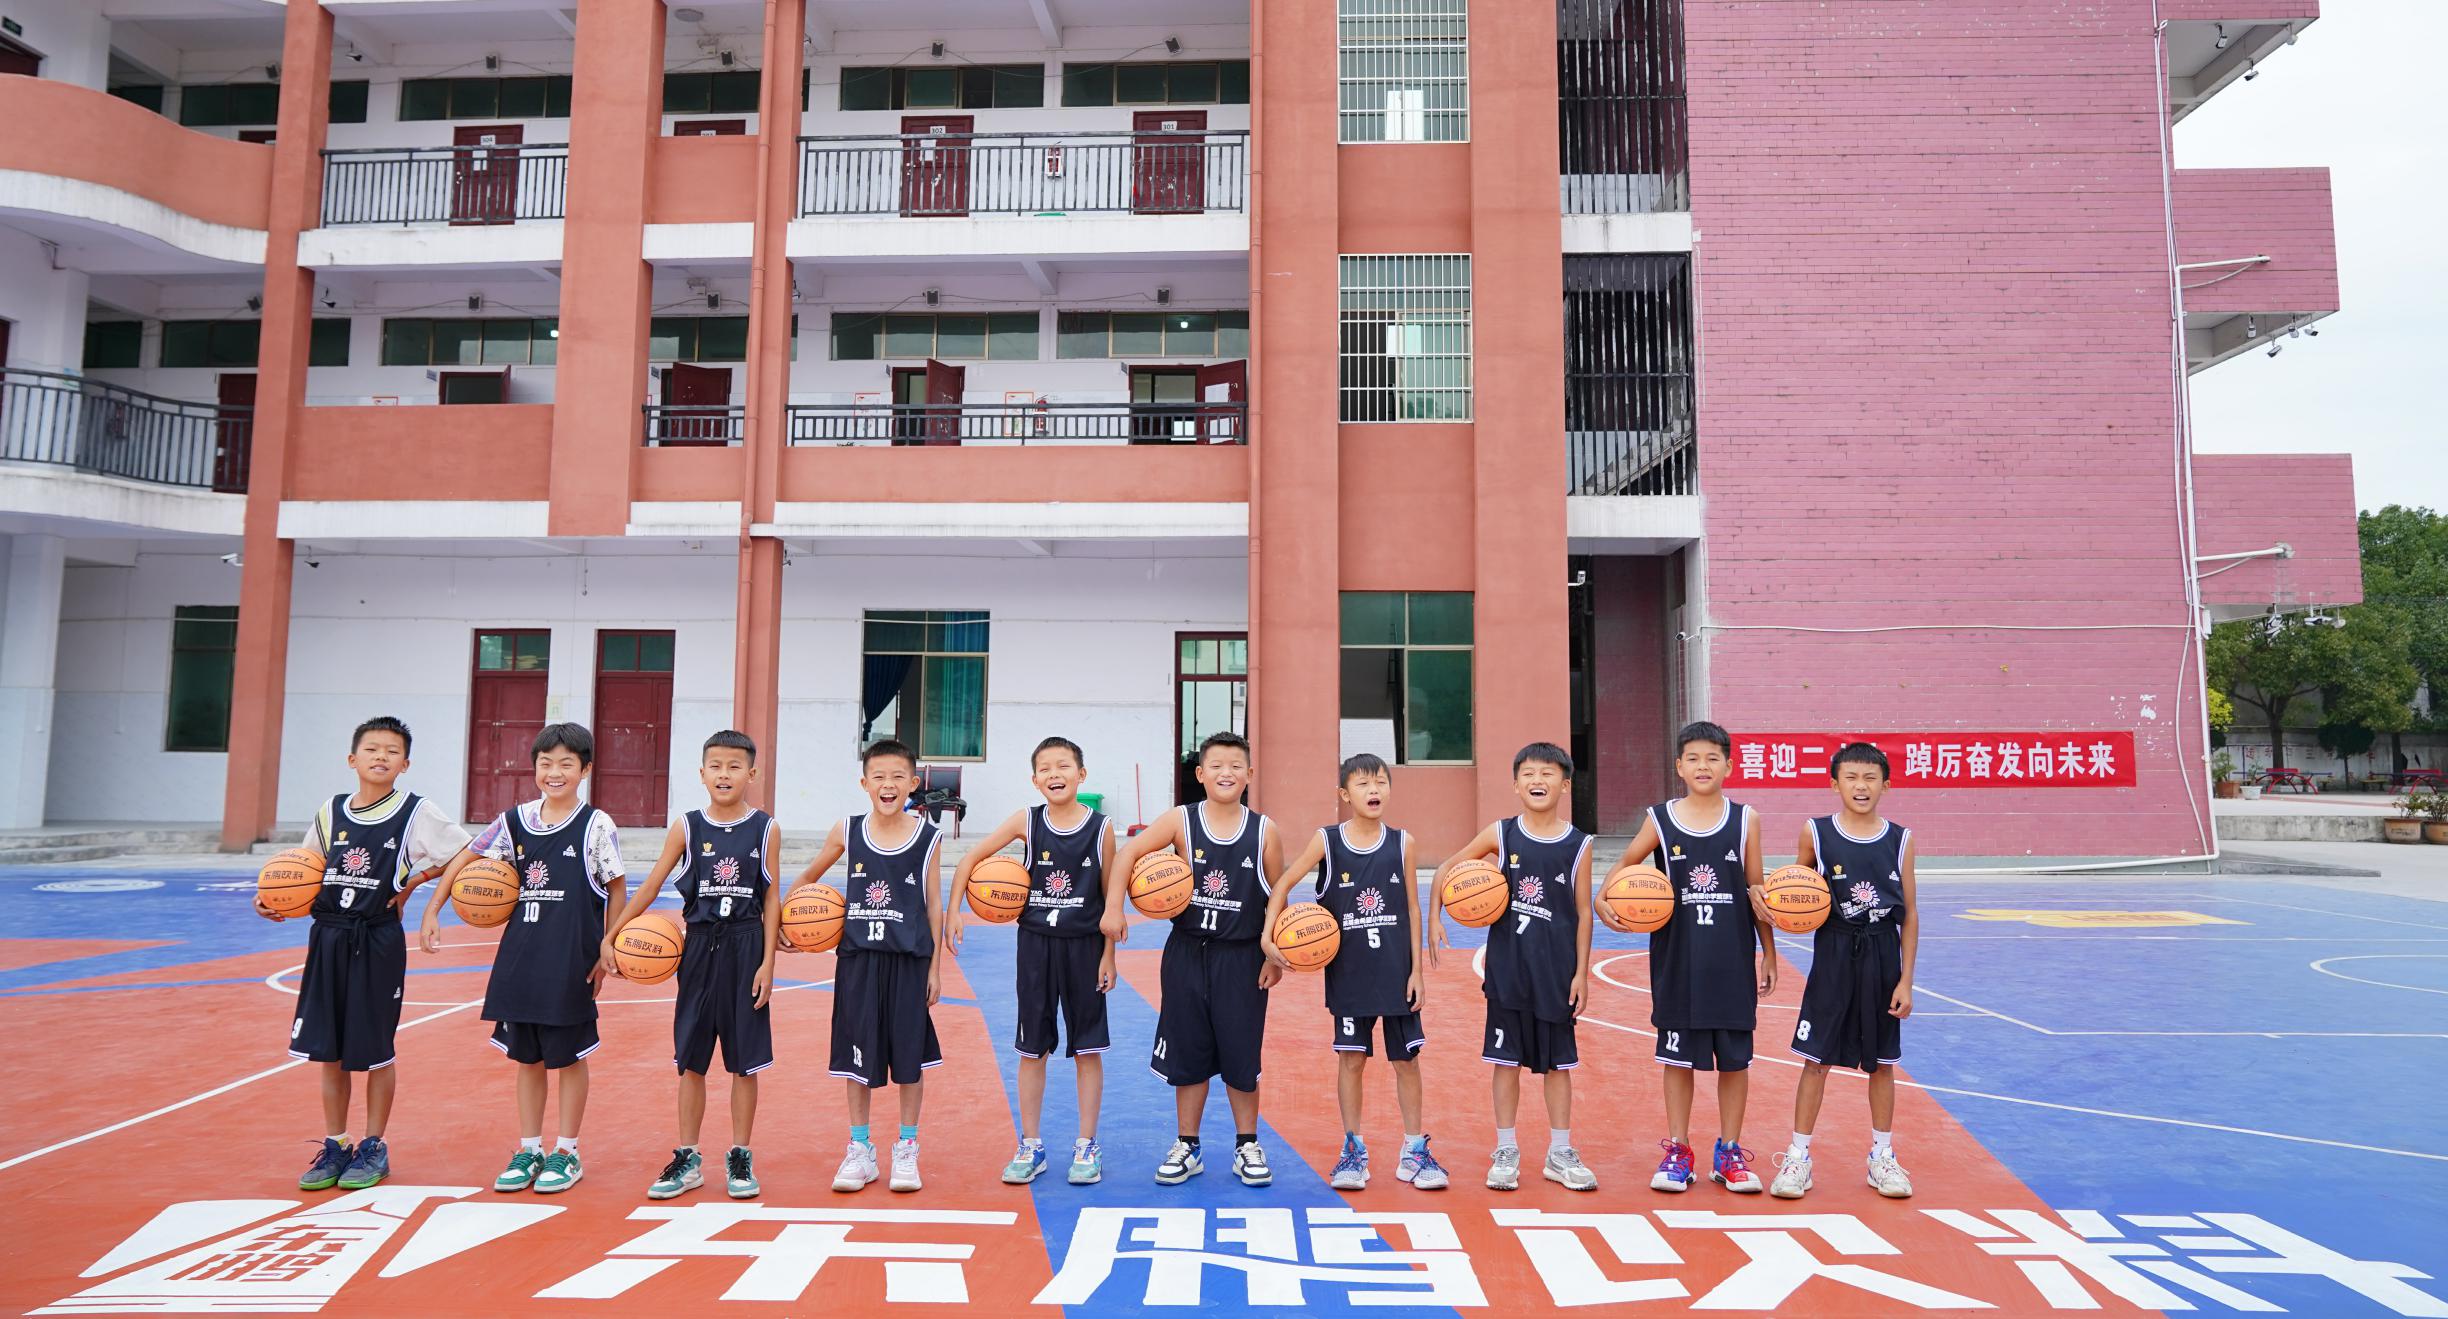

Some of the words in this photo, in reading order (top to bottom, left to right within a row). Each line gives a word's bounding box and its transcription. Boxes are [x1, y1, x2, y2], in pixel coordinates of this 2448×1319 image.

[1739, 742, 1887, 779] 喜迎二
[1905, 742, 2116, 779] 踔厉奋发向未来
[1146, 866, 1183, 884] 东鹏饮料
[1453, 875, 1491, 894] 东鹏饮料
[1770, 874, 1816, 886] ProSelect
[463, 884, 504, 899] 东鹏饮料
[1628, 880, 1666, 892] 东鹏饮料
[340, 888, 355, 908] 9
[720, 896, 732, 916] 6
[1780, 894, 1820, 904] 东鹏饮料
[523, 902, 540, 922] 10
[790, 905, 829, 916] 东鹏饮料
[1046, 909, 1059, 926] 4
[1201, 910, 1218, 930] 11
[1696, 905, 1713, 925] 12
[868, 921, 885, 941] 13
[1296, 920, 1332, 939] 东鹏饮料
[1516, 915, 1530, 934] 7
[624, 936, 663, 954] 东鹏饮料
[1367, 928, 1380, 948] 5
[292, 1018, 303, 1039] 9
[1343, 1017, 1354, 1036] 5
[1797, 1020, 1811, 1041] 8
[1495, 1028, 1504, 1048] 7
[1666, 1030, 1679, 1052] 12
[1154, 1037, 1167, 1060] 11
[534, 1203, 2446, 1317] 东鹏饮料
